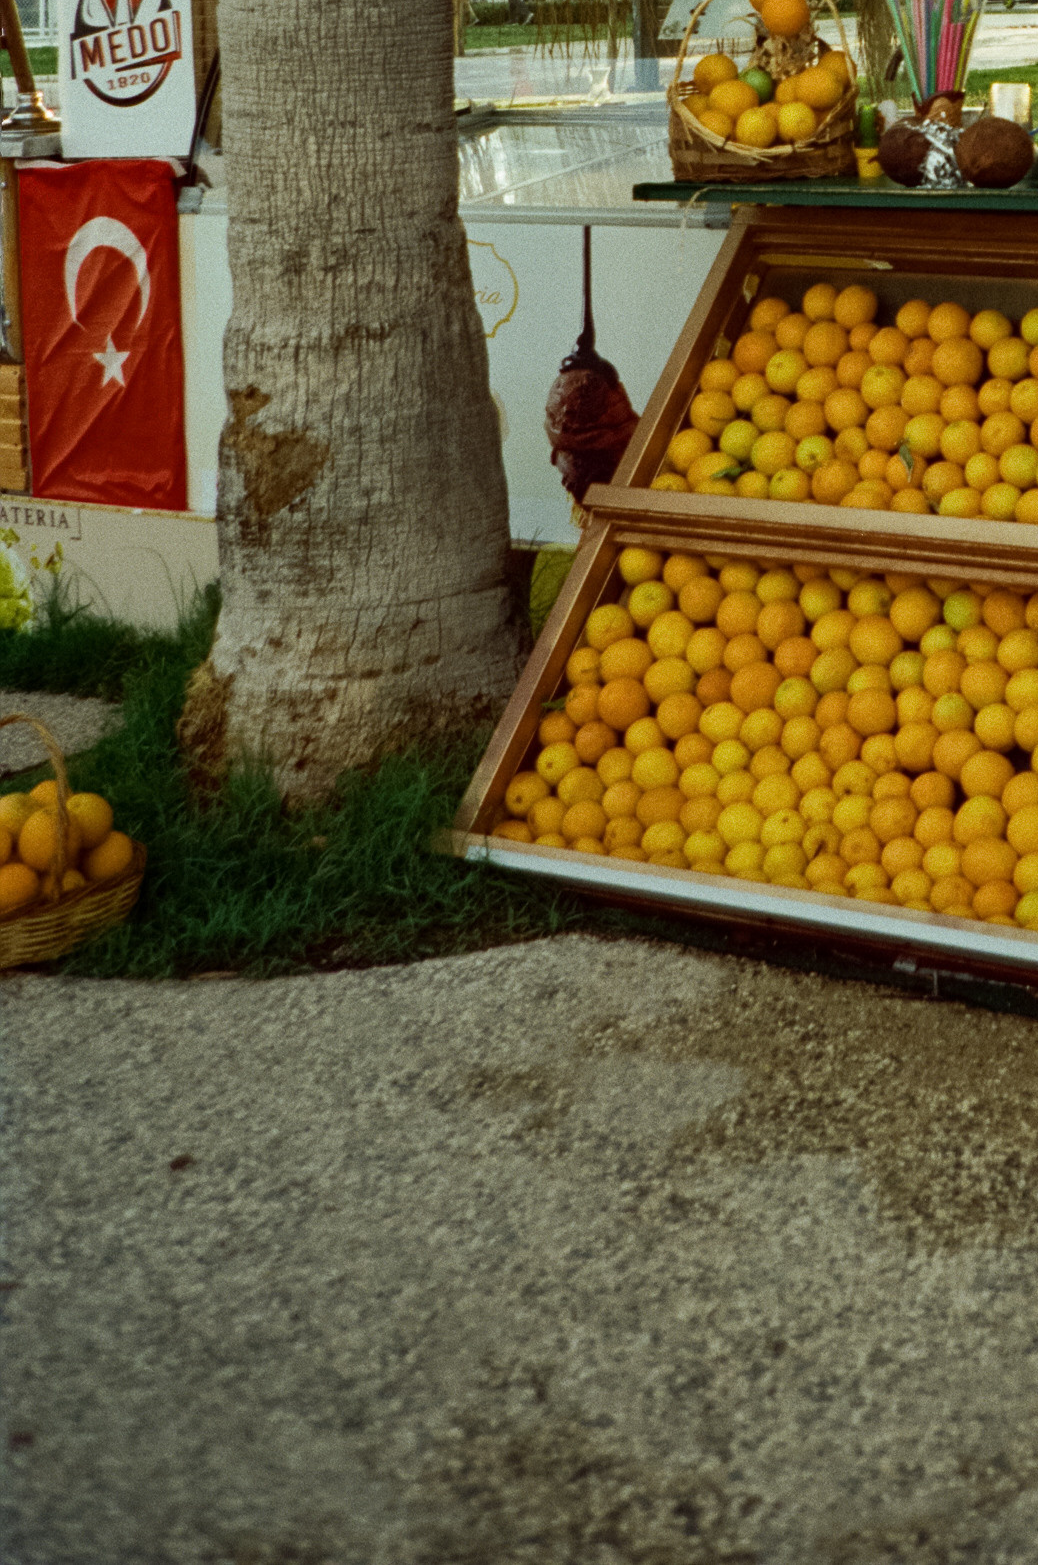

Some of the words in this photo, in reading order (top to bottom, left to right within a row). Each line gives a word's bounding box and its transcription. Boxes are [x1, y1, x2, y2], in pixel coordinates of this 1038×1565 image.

[80, 18, 171, 72] MEDO
[106, 72, 151, 90] 1820
[0, 506, 69, 529] ATERIA
